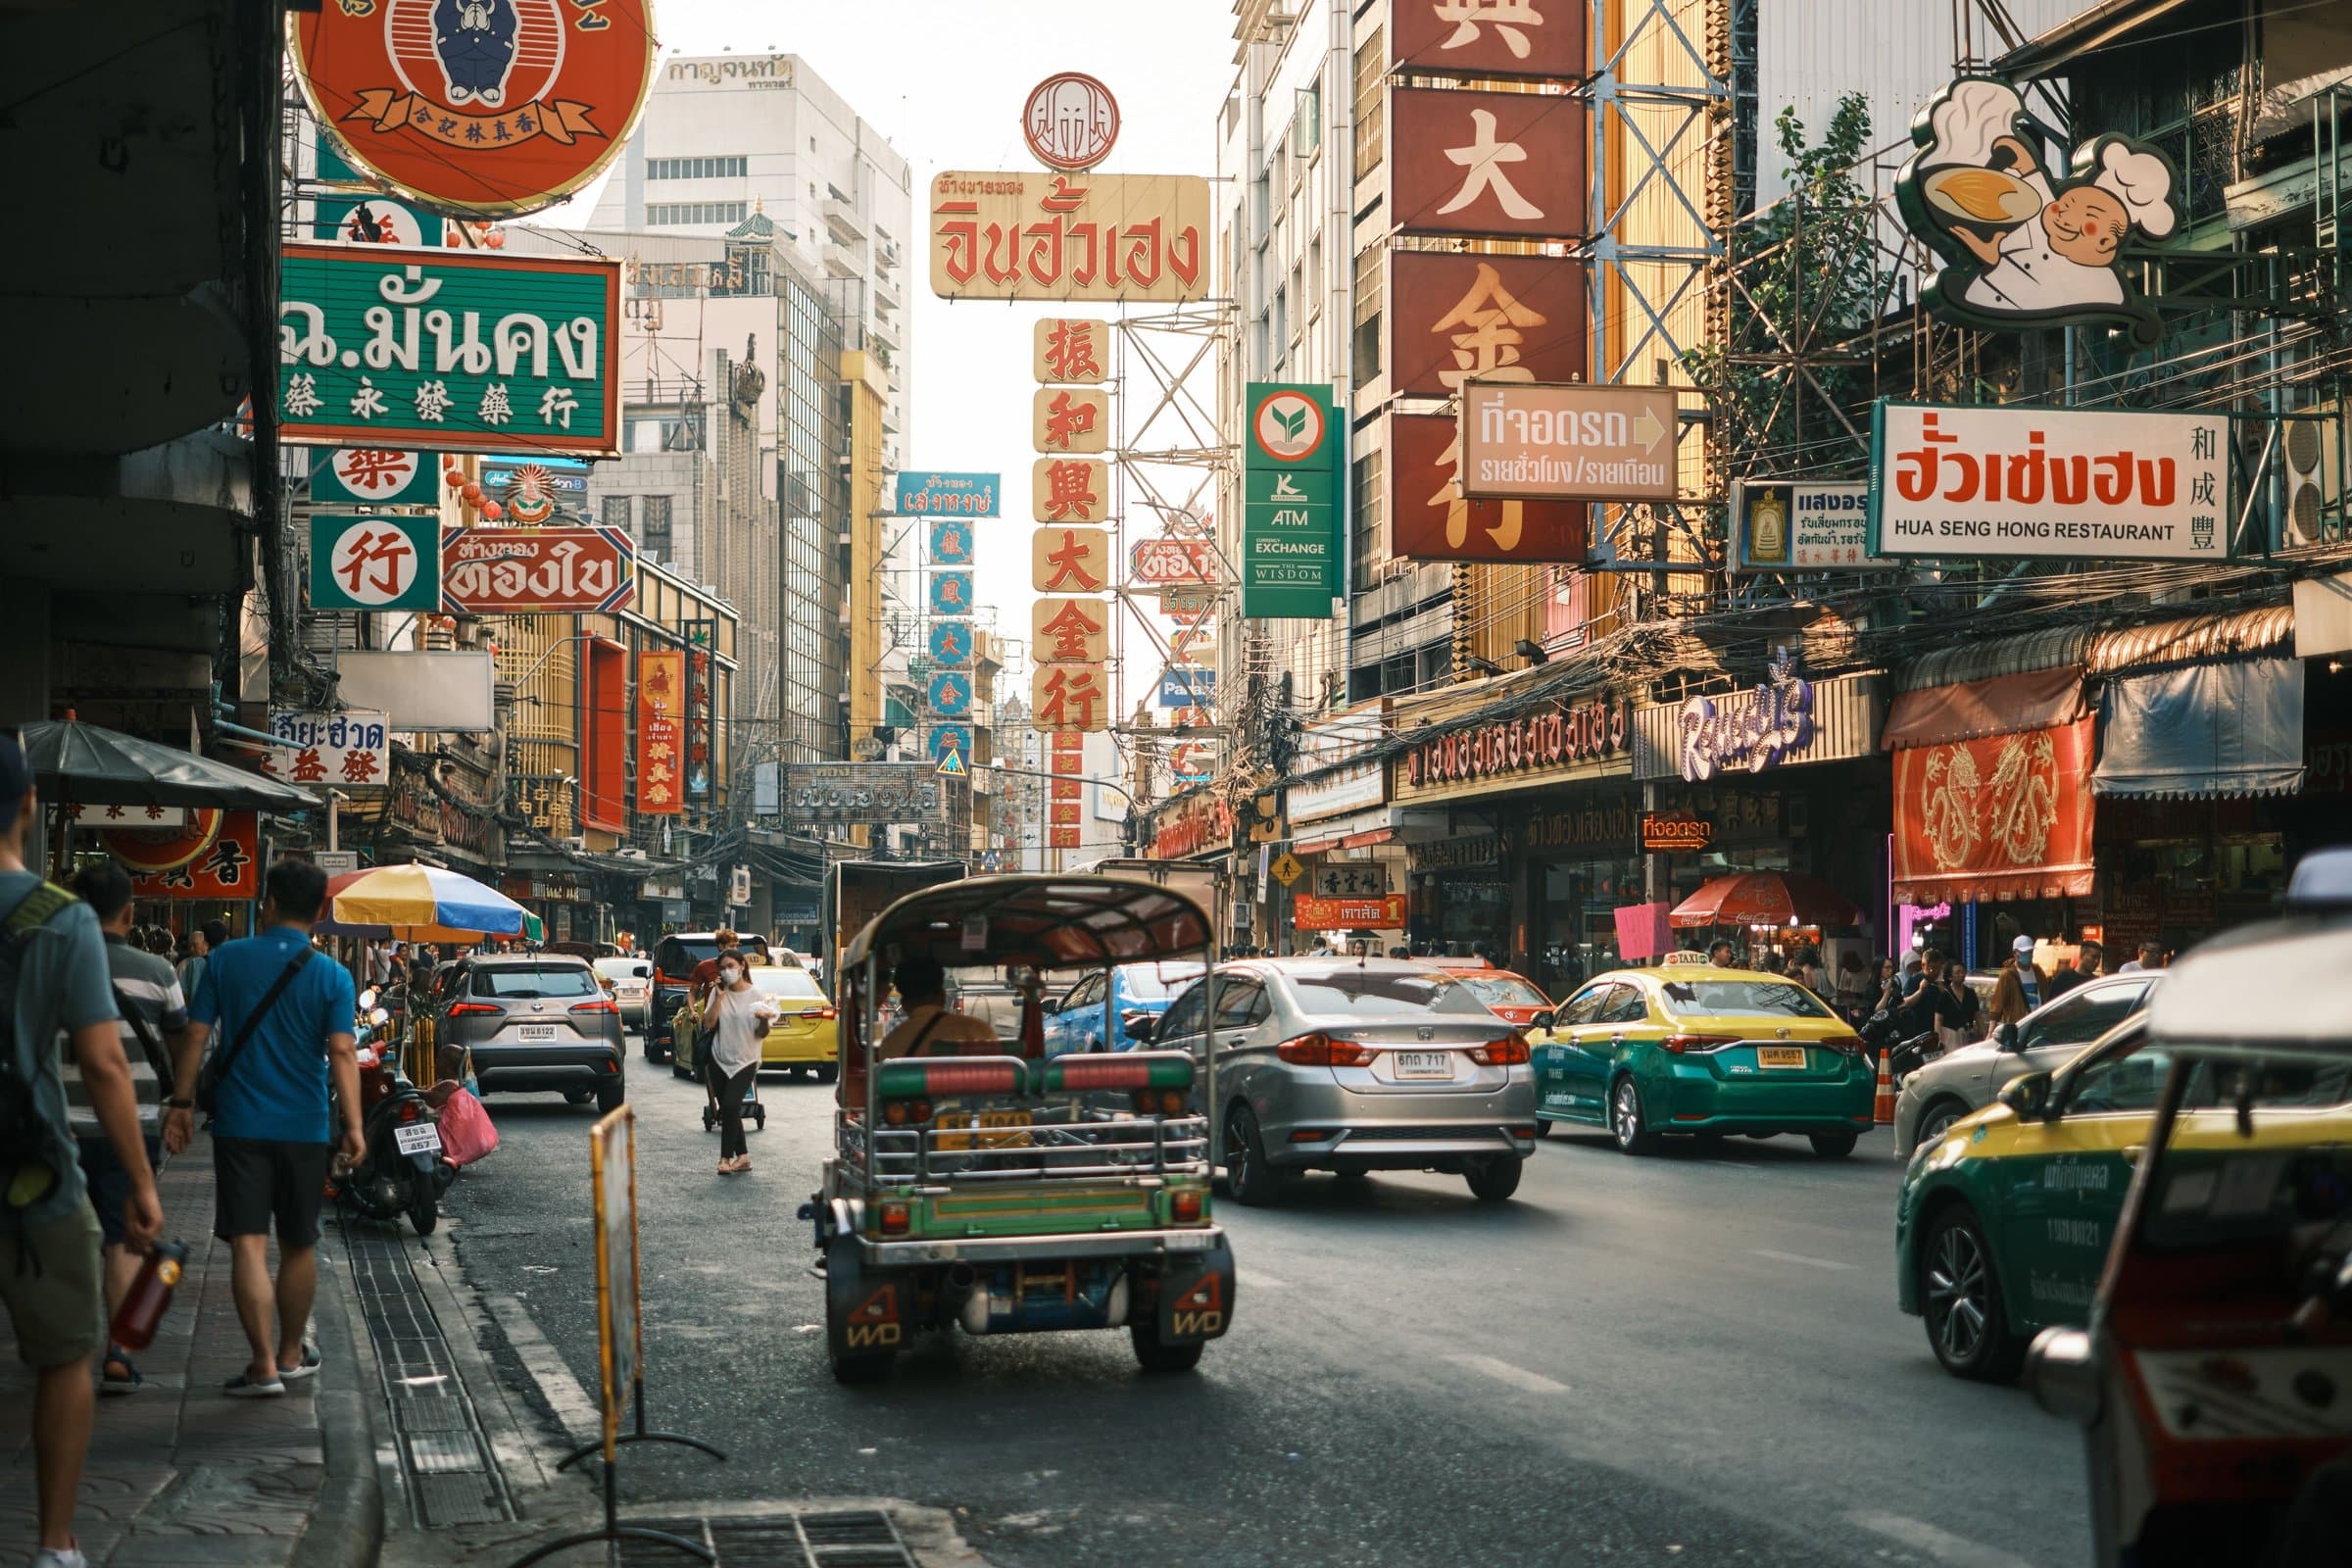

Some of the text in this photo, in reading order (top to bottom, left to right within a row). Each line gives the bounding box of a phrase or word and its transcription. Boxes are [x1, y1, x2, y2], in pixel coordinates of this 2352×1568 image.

[938, 172, 1023, 196] ห้างขายทอง
[1482, 391, 1628, 447] ที่จอดรถ
[1895, 413, 2176, 508] ฮั่วเซ่งฮง
[1277, 473, 1301, 495] K
[2188, 424, 2218, 551] 和成豐
[1043, 319, 1103, 730] 振和興大金行
[1271, 510, 1308, 526] ATM
[1894, 519, 2175, 541] HUA SENG HONG RESTAURANT
[1255, 543, 1325, 555] EXCHANGE
[449, 541, 613, 599] ทองใบ
[1255, 569, 1322, 580] WISDOM
[1642, 813, 1710, 837] ที่จอดรถ
[1678, 954, 1699, 963] TAXI
[1427, 1054, 1446, 1065] 717
[411, 1141, 430, 1151] 457
